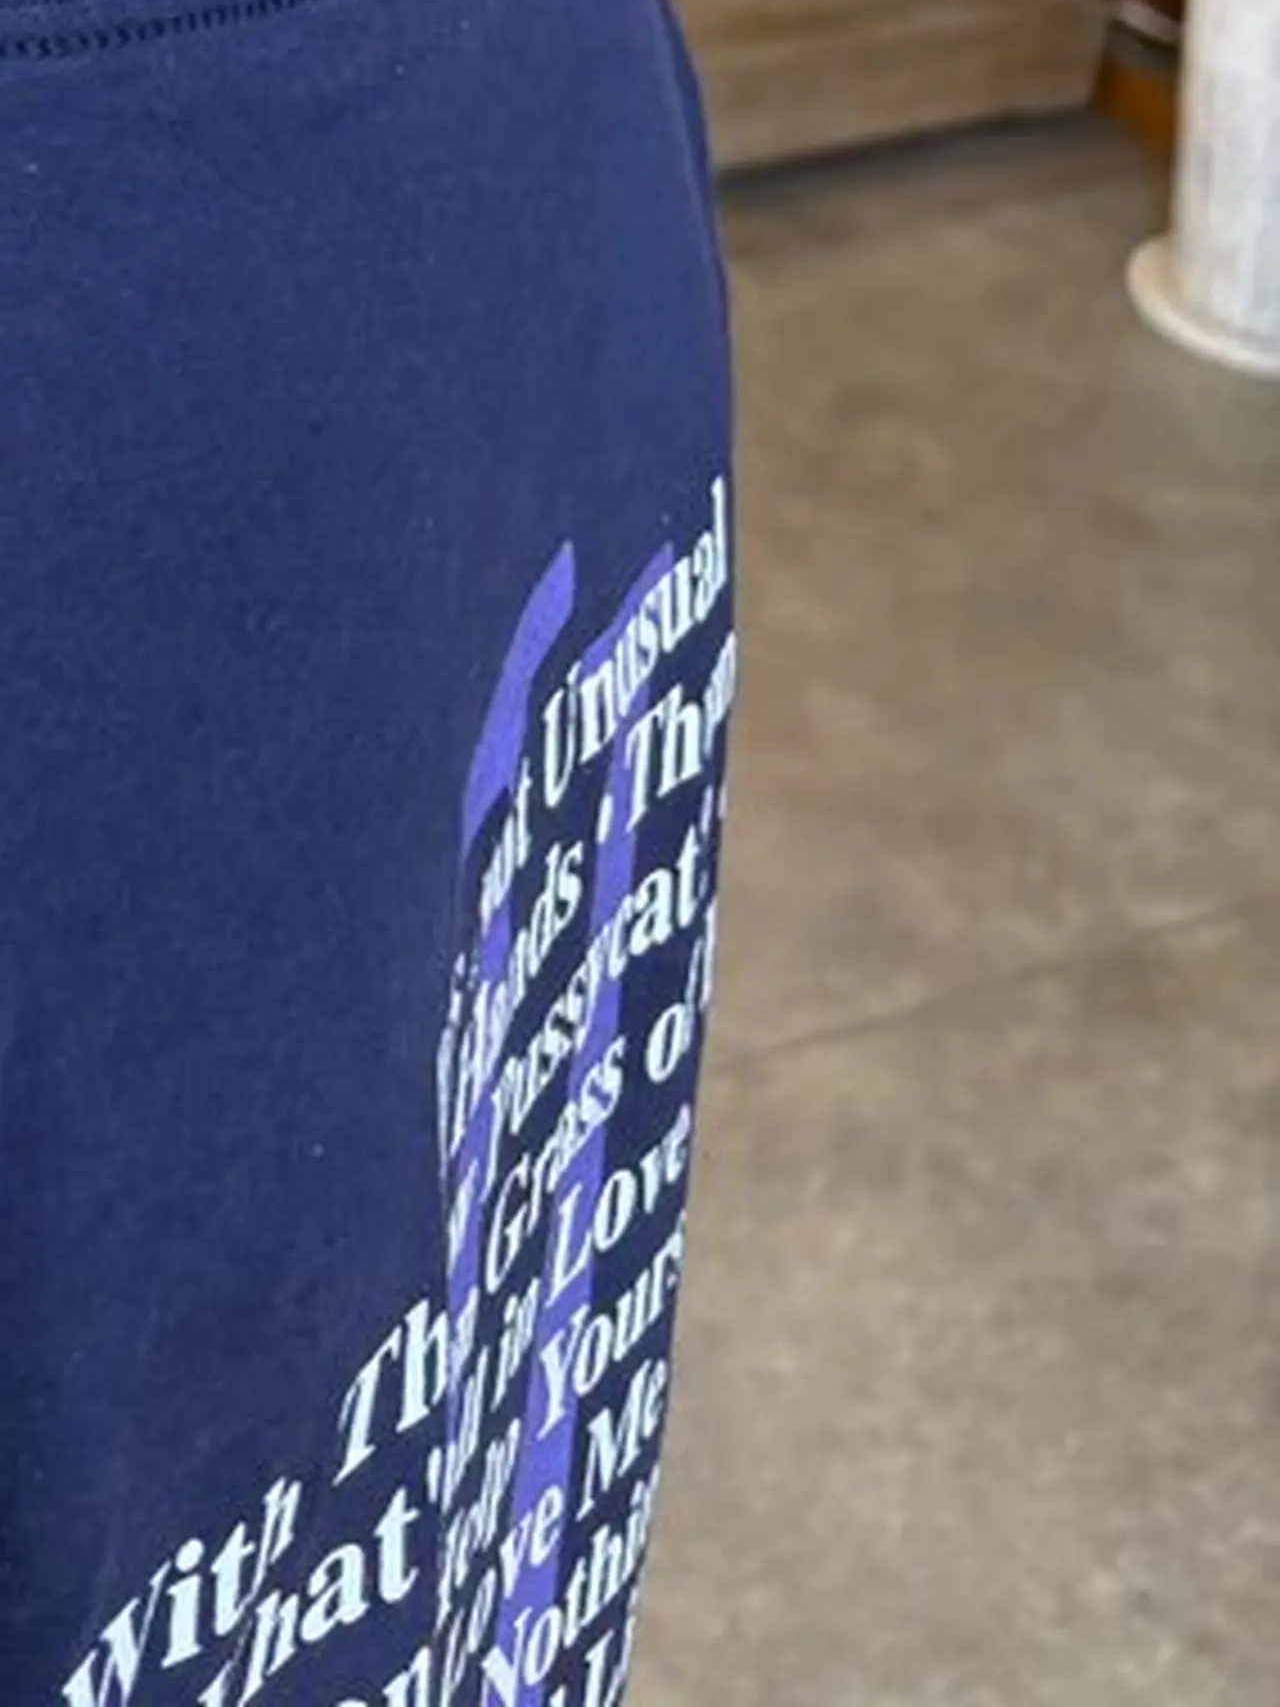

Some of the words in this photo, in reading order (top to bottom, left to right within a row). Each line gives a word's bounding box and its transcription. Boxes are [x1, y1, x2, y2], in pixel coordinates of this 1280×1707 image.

[542, 475, 727, 808] Unusual
[485, 1035, 628, 1294] Grass
[545, 1101, 691, 1308] Love
[575, 1358, 667, 1522] Me
